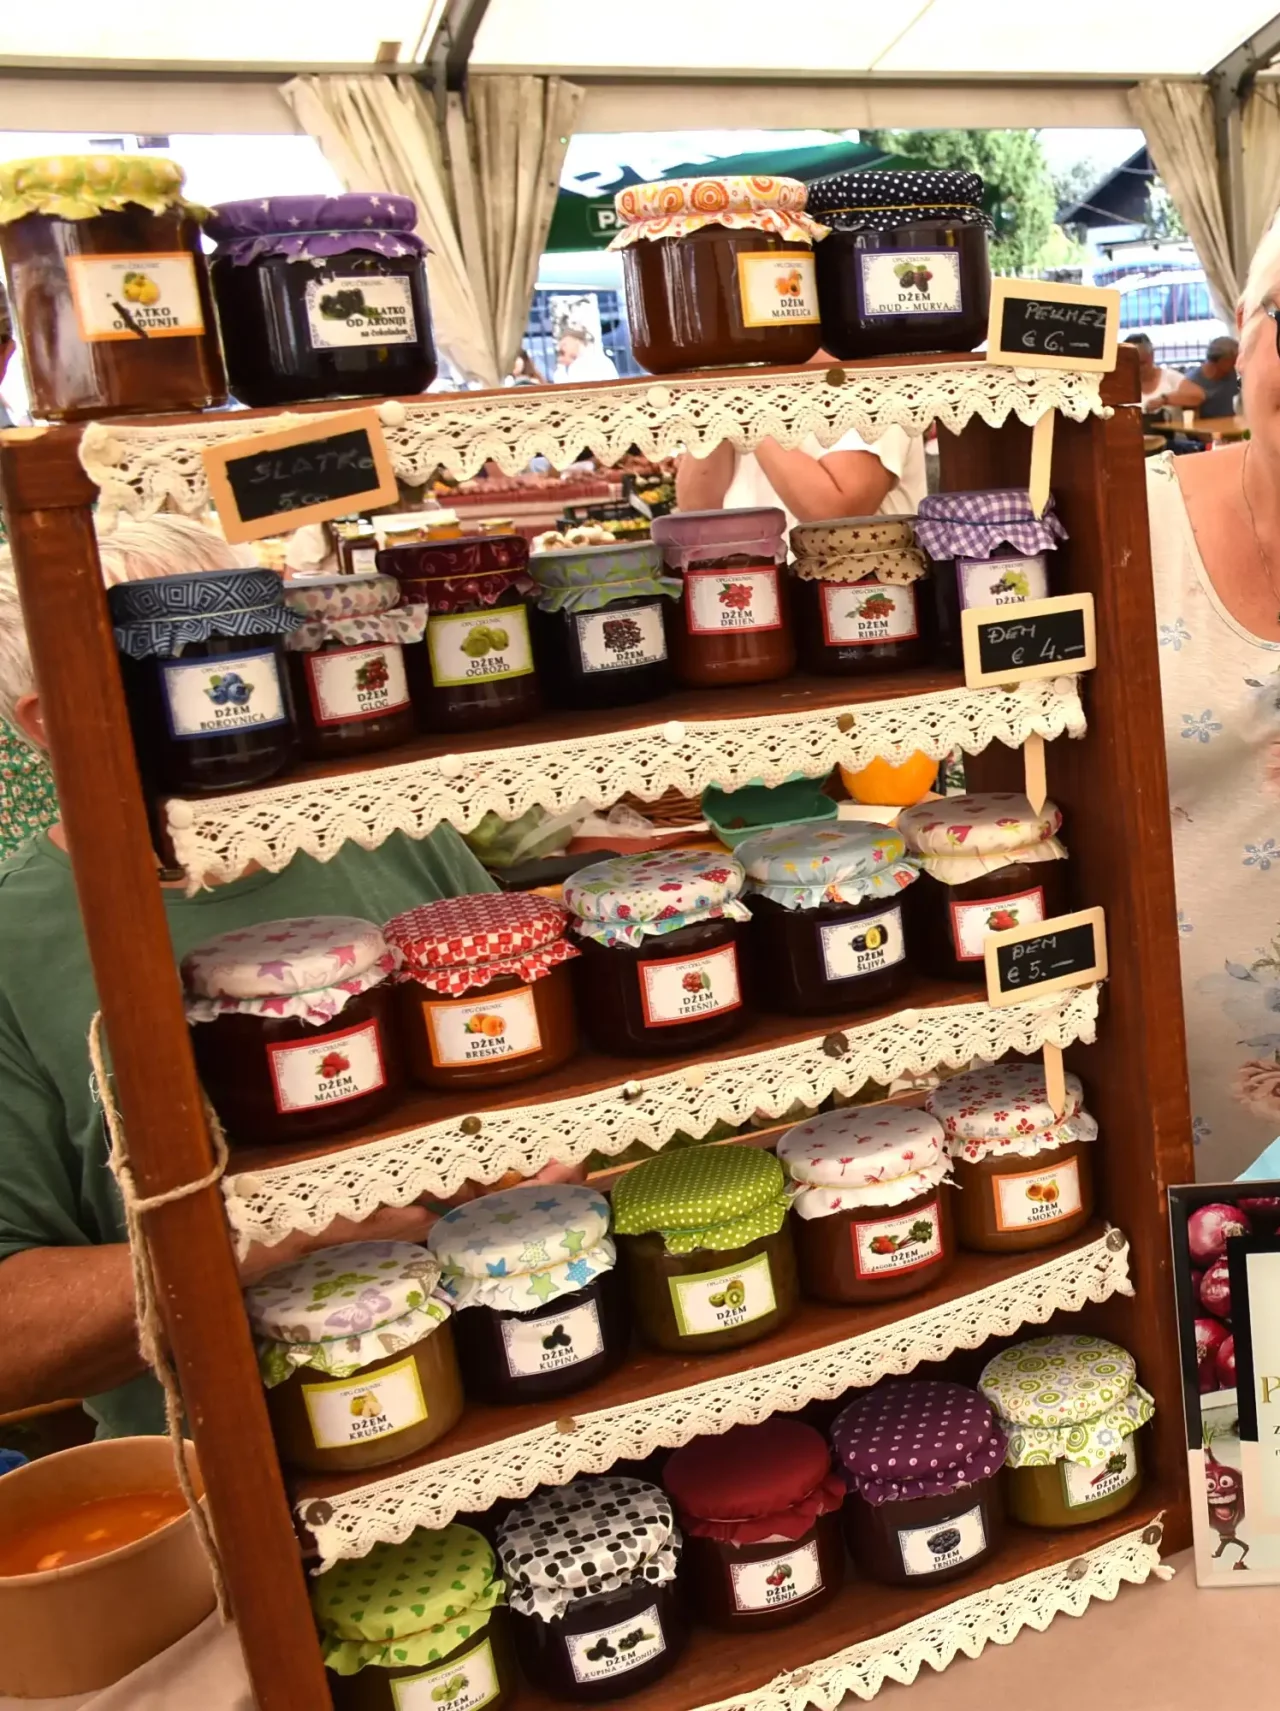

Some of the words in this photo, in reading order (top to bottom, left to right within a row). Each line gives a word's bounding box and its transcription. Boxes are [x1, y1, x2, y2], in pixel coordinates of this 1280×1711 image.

[781, 298, 805, 308] DŽEM
[897, 291, 931, 302] DŽEM
[368, 306, 406, 316] SLATKO
[771, 308, 811, 318] MARELICA
[879, 303, 902, 313] DUD
[913, 302, 949, 311] MURVA
[138, 317, 179, 328] DUNJE
[346, 318, 364, 327] OD
[368, 316, 406, 327] ARONIJE
[1021, 330, 1037, 348] €
[995, 595, 1026, 605] DŽEM
[720, 617, 755, 626] DRIJEN
[721, 608, 753, 620] DŽEM
[857, 619, 889, 630] DŽEM
[470, 656, 504, 669] DŽEM
[616, 650, 644, 661] DŽEM
[1011, 648, 1024, 666] €
[466, 664, 510, 677] OGROZD
[357, 688, 389, 703] DŽEM
[214, 705, 251, 719] DŽEM
[361, 697, 389, 712] GLOG
[200, 712, 266, 730] BOROVNICA
[857, 949, 884, 964] DŽEM
[857, 958, 887, 972] ŠLJIVA
[1007, 966, 1020, 983] €
[682, 991, 715, 1006] DŽEM
[678, 999, 720, 1015] TREŠNJA
[471, 1035, 506, 1050] DŽEM
[465, 1043, 514, 1060] BRESKVA
[318, 1075, 353, 1092] DŽEM
[314, 1084, 360, 1103] MALINA
[1026, 1208, 1063, 1223] SMOKVA
[1031, 1202, 1059, 1215] DŽEM
[890, 1249, 919, 1262] DŽEM
[715, 1304, 748, 1320] DŽEM
[723, 1315, 745, 1328] KIVI
[541, 1345, 575, 1362] DŽEM
[538, 1353, 580, 1371] KUPINA
[351, 1414, 387, 1431] DŽEM
[348, 1421, 394, 1440] KRUŠKA
[1085, 1476, 1130, 1502] RABARBARA
[1096, 1474, 1120, 1491] DŽEM
[934, 1548, 960, 1563] DŽEM
[932, 1556, 964, 1571] TRNINA
[765, 1588, 799, 1604] VIŠNJA
[766, 1582, 796, 1597] DŽEM
[584, 1665, 618, 1680] KUPINA
[625, 1647, 659, 1669] ARONIJA
[605, 1650, 637, 1668] DŽEM
[438, 1695, 469, 1711] DŽEM
